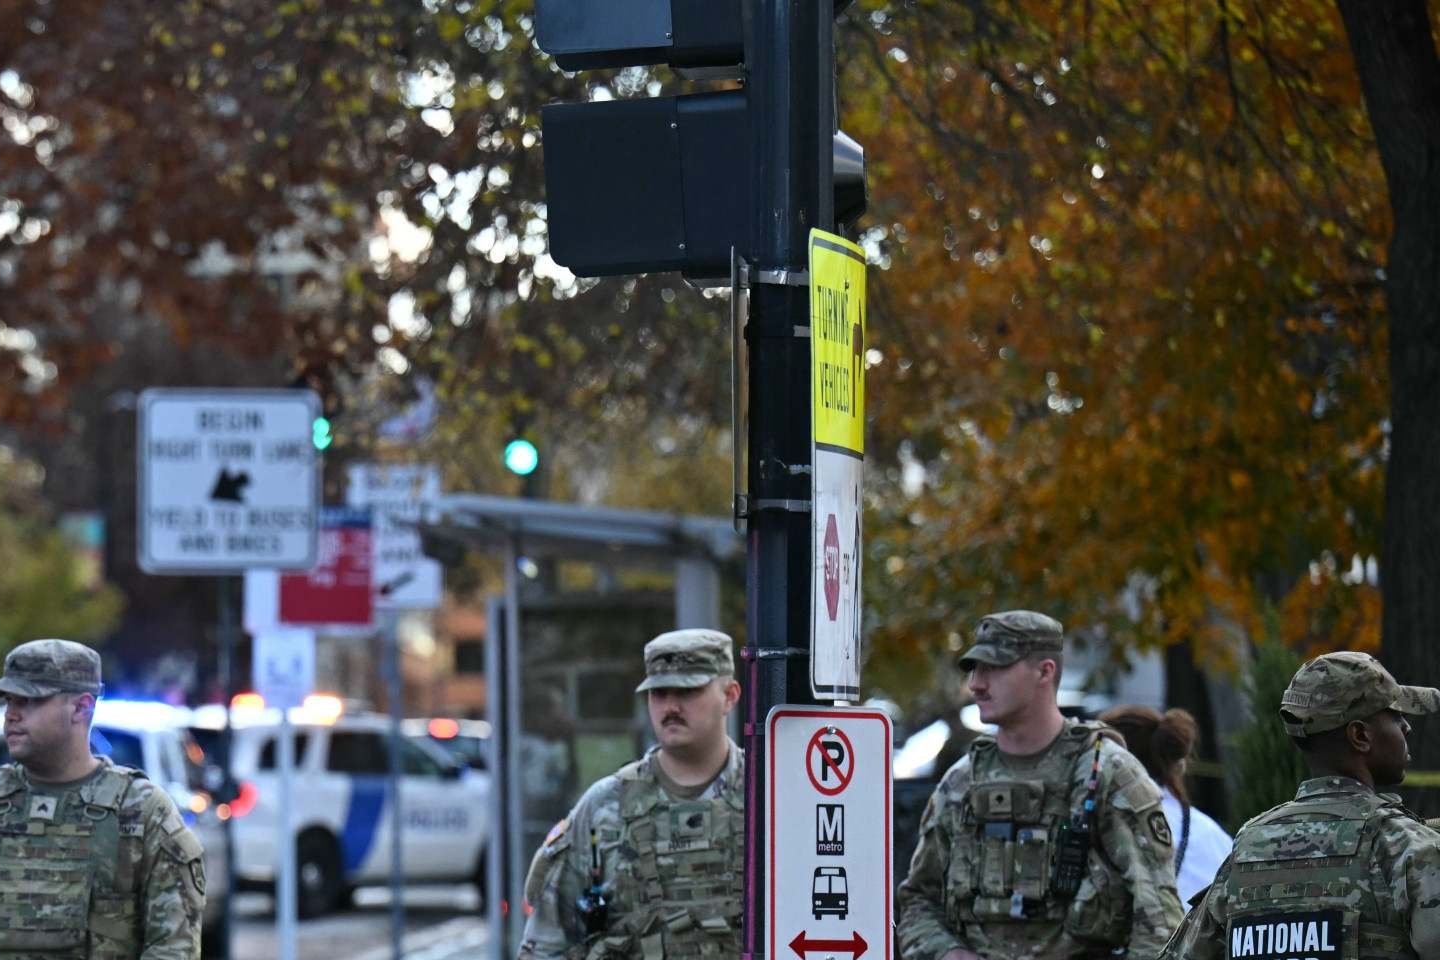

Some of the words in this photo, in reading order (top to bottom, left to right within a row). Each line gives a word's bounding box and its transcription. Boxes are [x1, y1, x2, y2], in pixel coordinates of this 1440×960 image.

[824, 546, 838, 581] STOP
[821, 741, 845, 781] P
[818, 806, 843, 842] M
[818, 842, 843, 852] metro
[1232, 921, 1336, 958] NATIONAL
